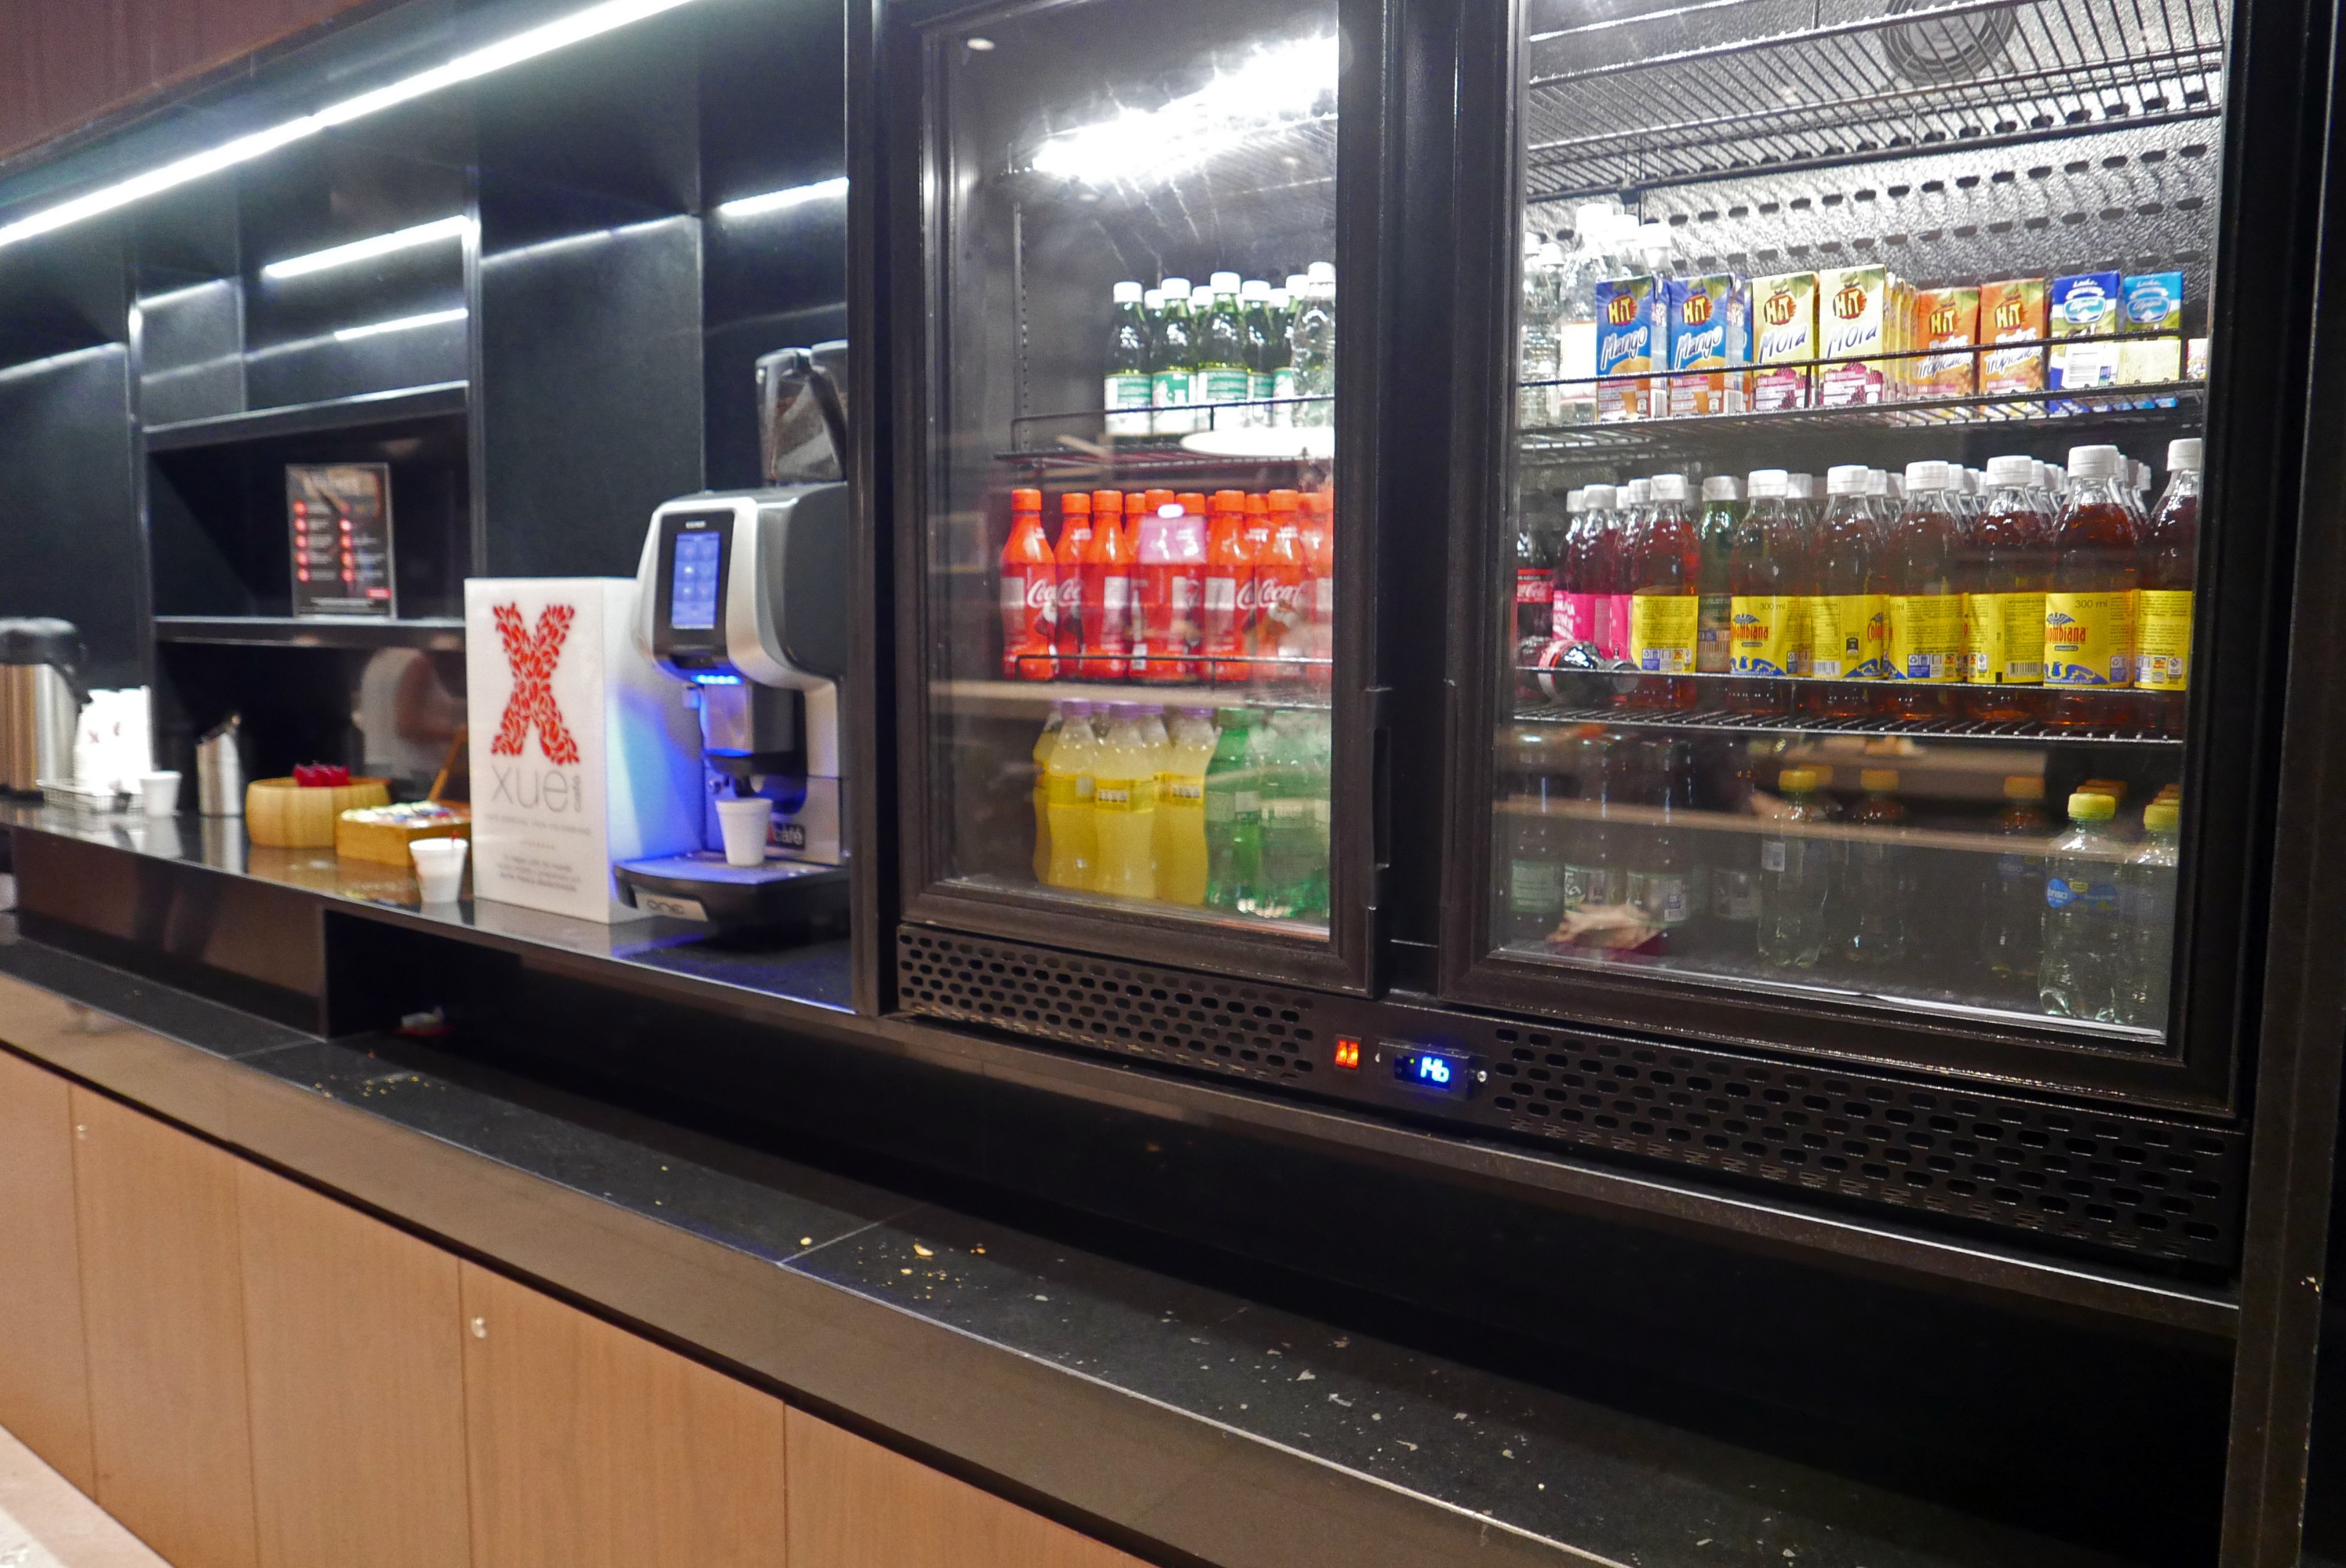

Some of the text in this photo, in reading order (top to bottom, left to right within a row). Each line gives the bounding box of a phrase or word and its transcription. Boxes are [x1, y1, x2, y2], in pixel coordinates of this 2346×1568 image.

[1601, 326, 1648, 370] Mango
[1674, 326, 1723, 370] Mango
[2075, 599, 2108, 609] 300 ml
